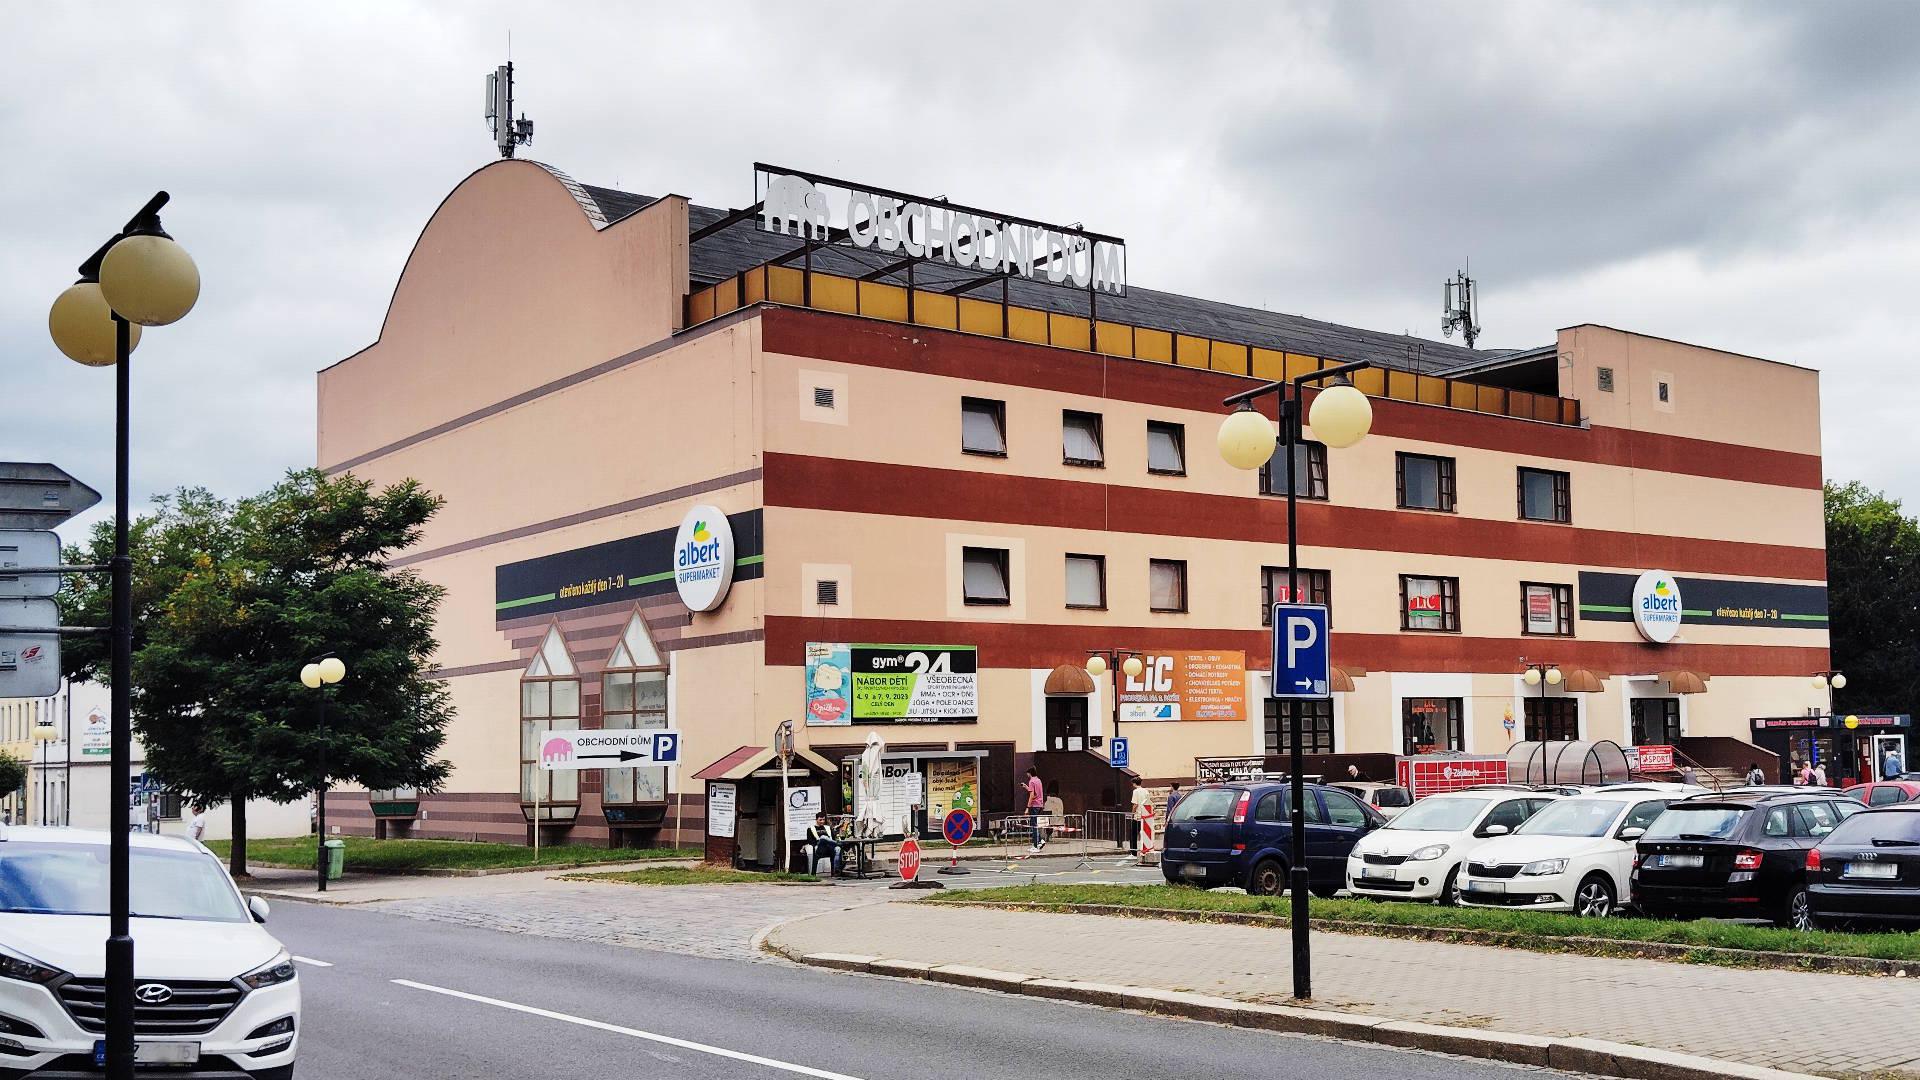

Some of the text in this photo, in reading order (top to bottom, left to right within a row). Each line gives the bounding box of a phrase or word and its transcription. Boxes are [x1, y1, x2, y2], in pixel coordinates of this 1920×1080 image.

[847, 192, 1122, 294] OBCHODNÍ DŮM
[679, 541, 720, 567] albert
[679, 567, 720, 584] SUPERMARKET
[1642, 594, 1678, 611] albert
[1643, 611, 1678, 623] SUPERMARKET
[1287, 616, 1317, 668] P
[905, 651, 954, 674] 24
[857, 675, 908, 686] NÁBOR DĚTÍ
[926, 675, 973, 684] VŠEOBECNÁ
[912, 698, 930, 706] JÓGA
[943, 707, 957, 715] KICK
[961, 707, 974, 715] BOX
[577, 734, 673, 760] OBCHODNÍ DŮM P
[1114, 741, 1125, 759] P
[1648, 755, 1669, 764] SPORT
[1200, 767, 1223, 778] TENIS
[900, 851, 918, 869] STOP
